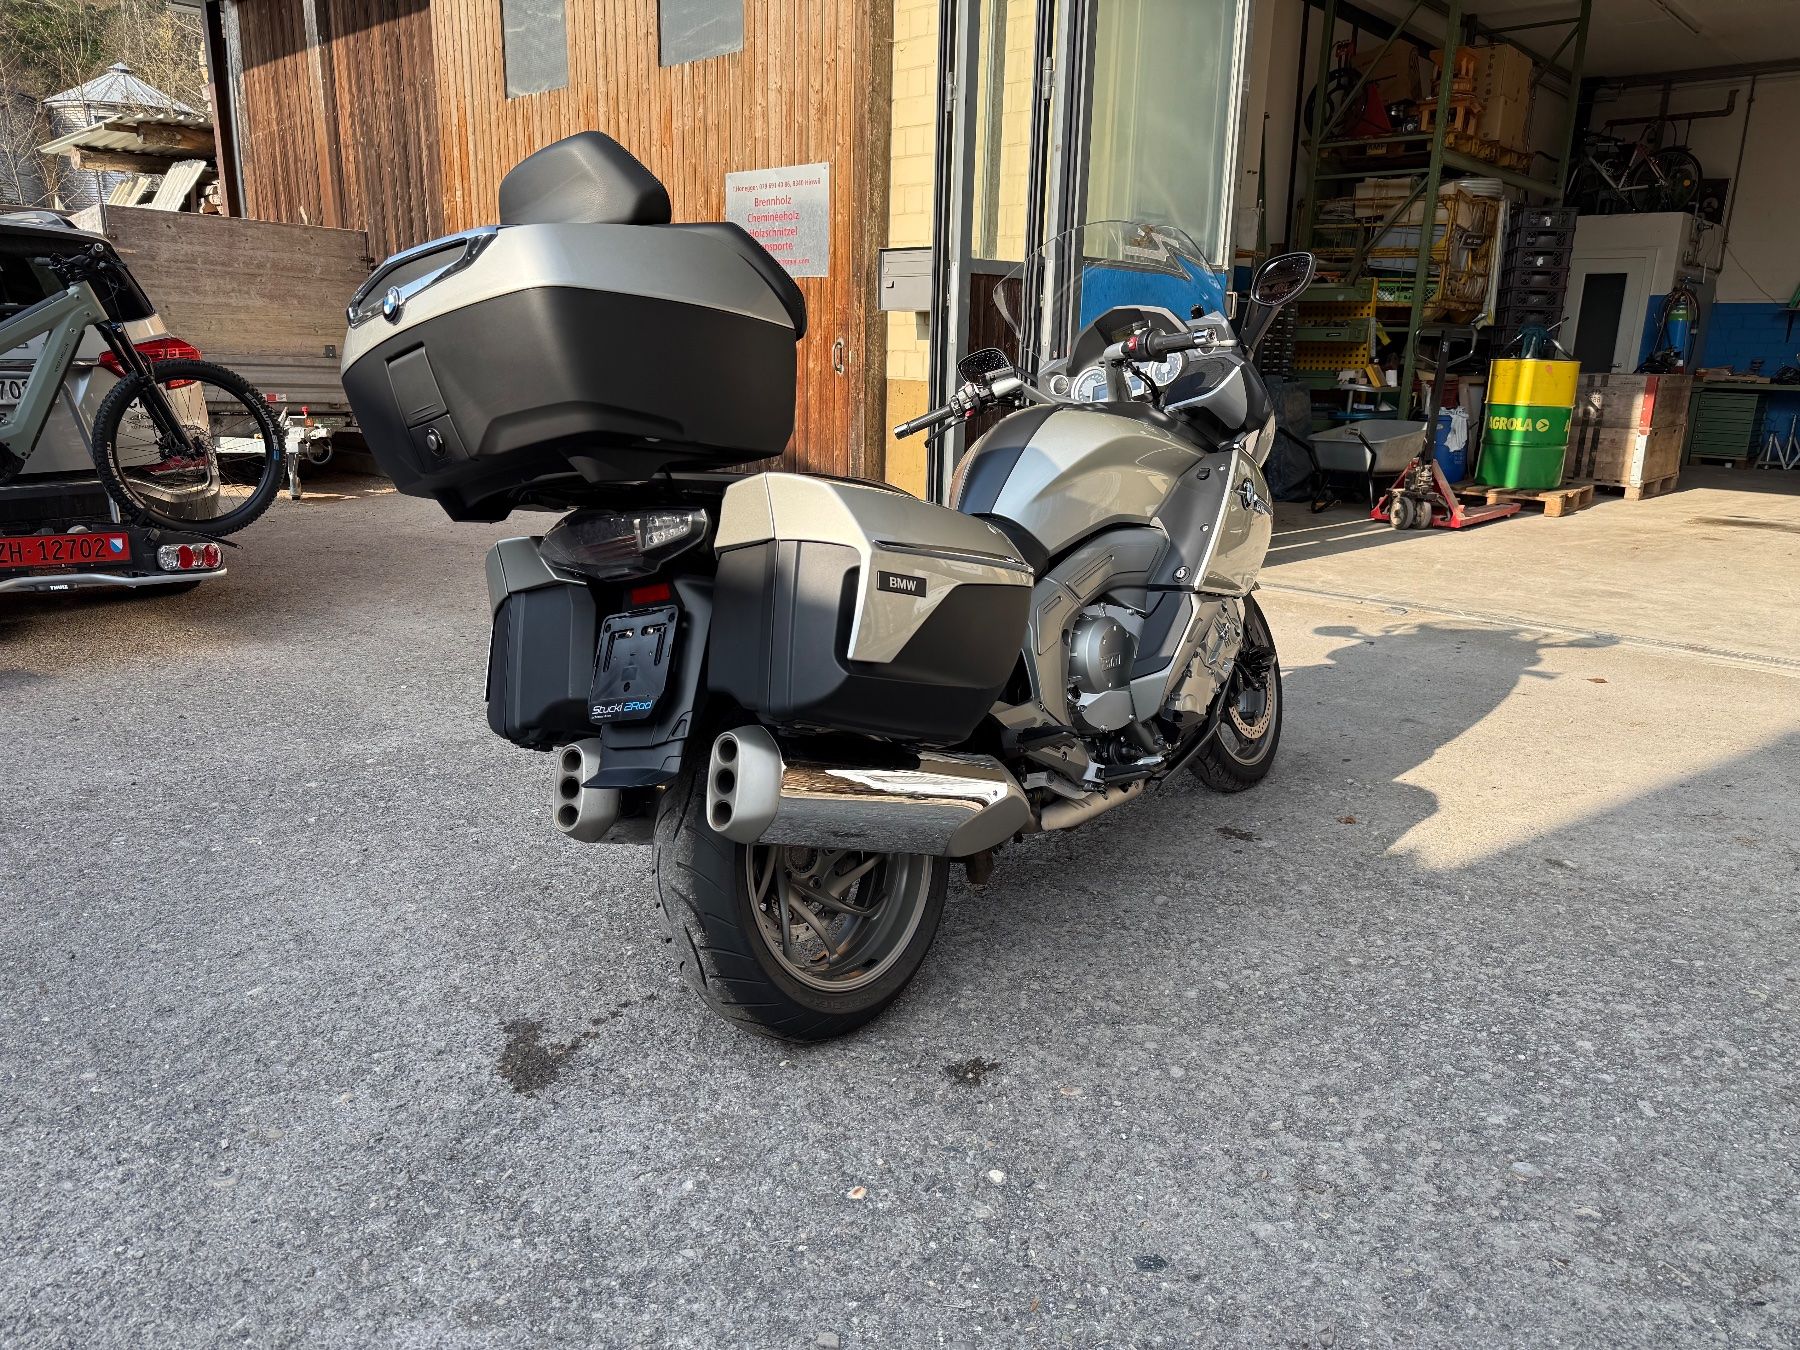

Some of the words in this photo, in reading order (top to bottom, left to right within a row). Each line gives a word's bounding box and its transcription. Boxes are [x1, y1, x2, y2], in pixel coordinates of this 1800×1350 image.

[755, 195, 791, 207] Brennholz
[748, 211, 800, 222] Cheminéeholz
[749, 226, 798, 238] Holzschnitzel
[243, 391, 280, 452] SCHWALBE
[1488, 415, 1533, 432] AGROLA
[36, 537, 107, 561] 12702
[889, 576, 917, 591] BMW
[592, 702, 624, 714] Stucki
[624, 700, 653, 711] 2Rad
